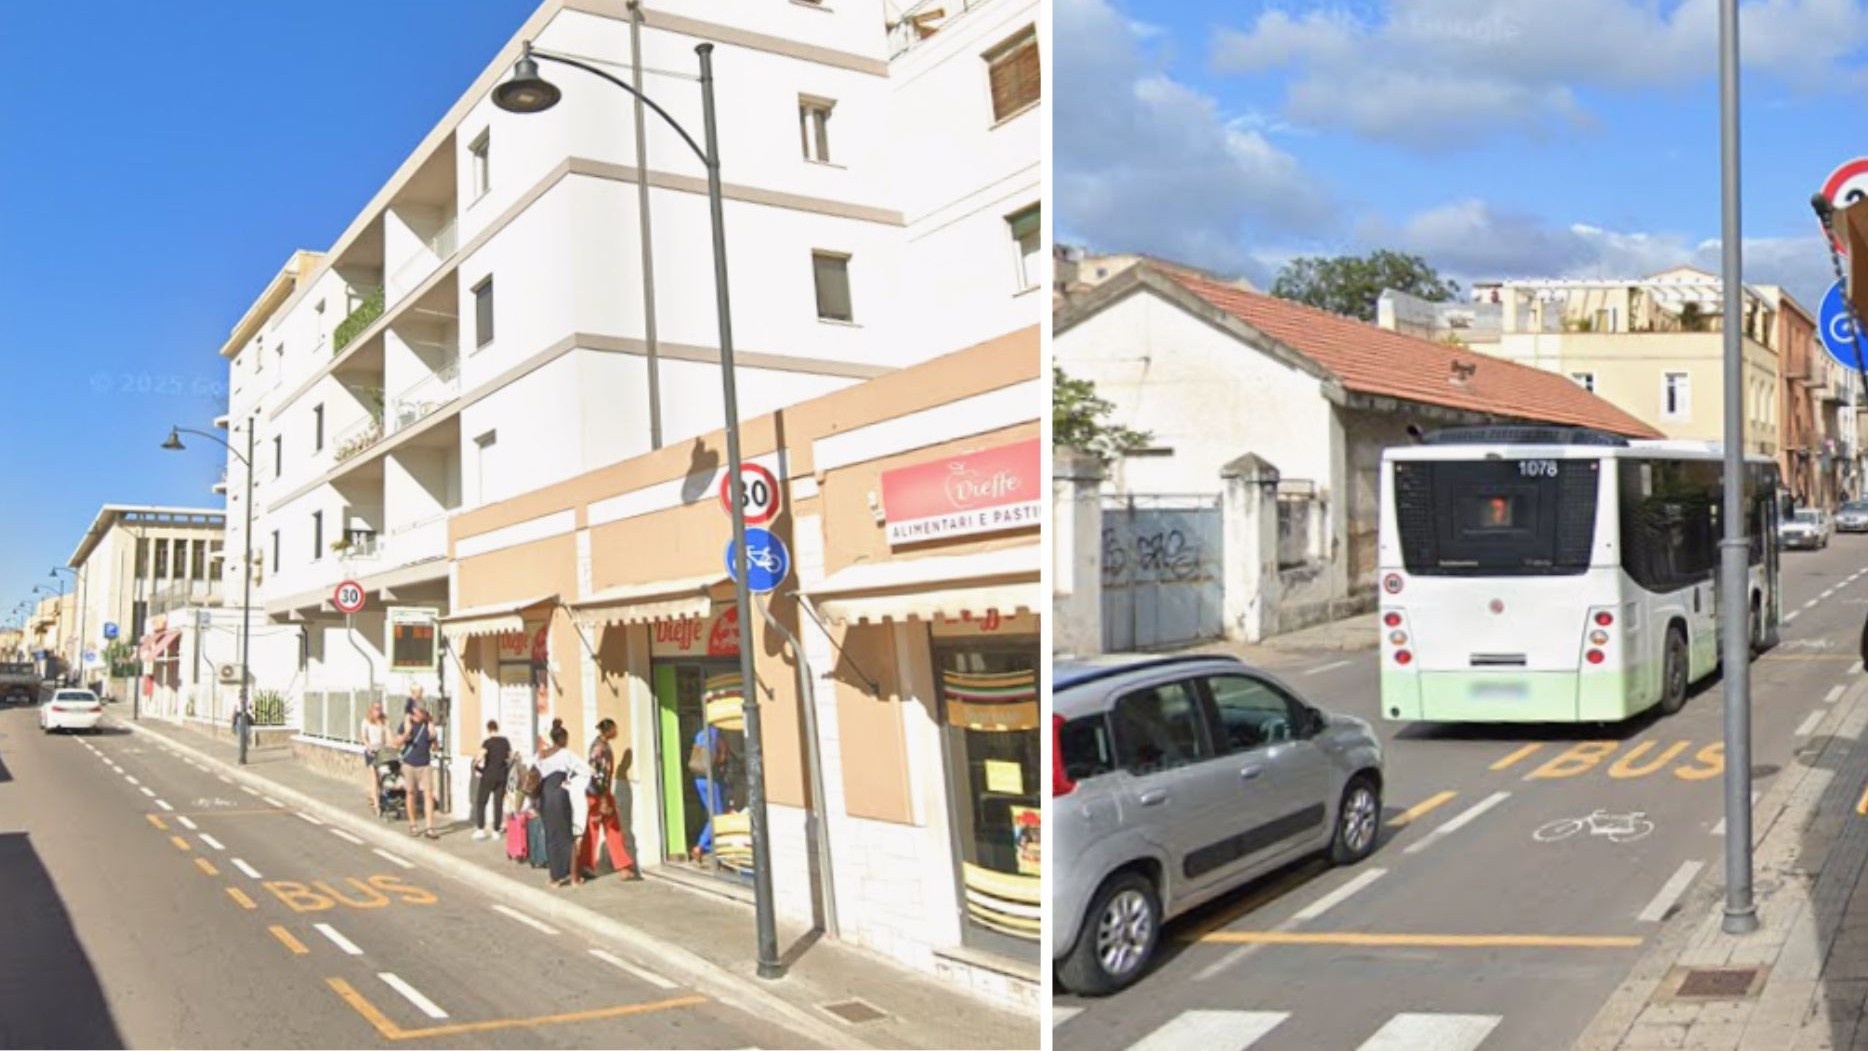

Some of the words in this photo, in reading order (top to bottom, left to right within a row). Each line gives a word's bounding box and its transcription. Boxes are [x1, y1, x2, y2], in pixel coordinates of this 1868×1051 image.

[1518, 459, 1558, 477] 1078
[892, 514, 973, 540] ALIMENTARI
[979, 512, 987, 526] E
[994, 504, 1041, 523] PASTI
[342, 588, 358, 604] 30
[1521, 740, 1725, 781] BUS
[262, 875, 438, 912] BUS
